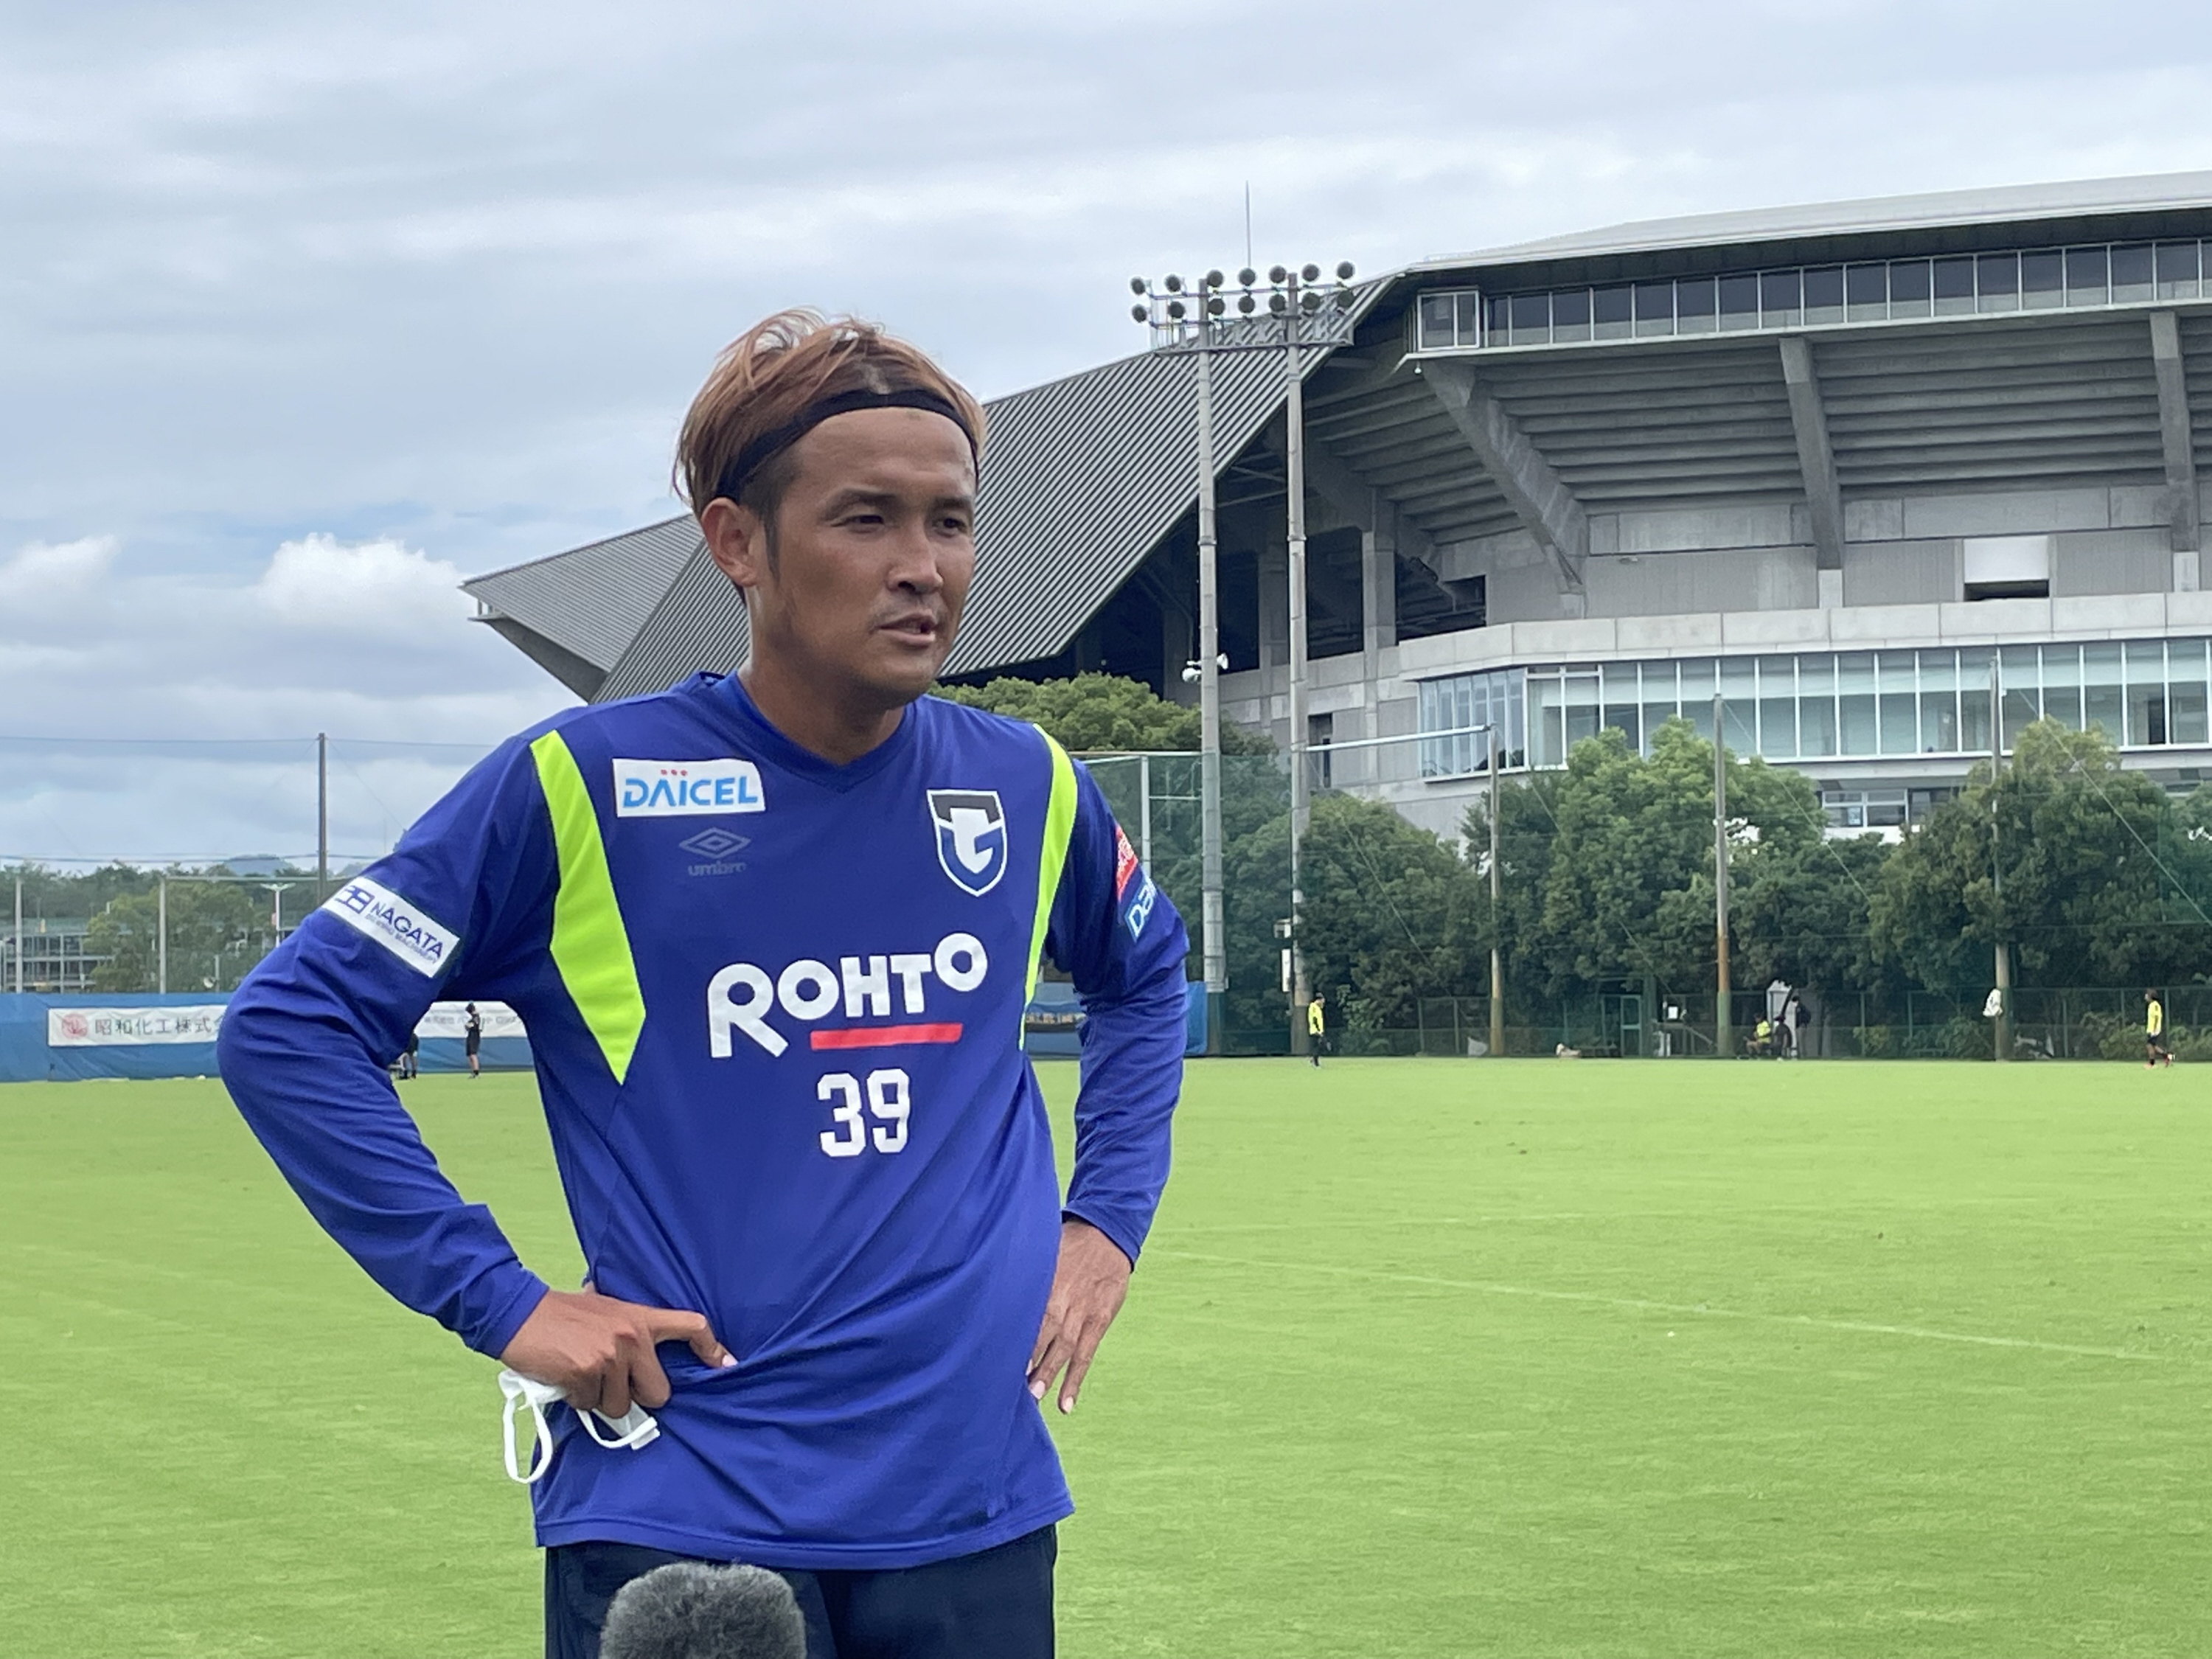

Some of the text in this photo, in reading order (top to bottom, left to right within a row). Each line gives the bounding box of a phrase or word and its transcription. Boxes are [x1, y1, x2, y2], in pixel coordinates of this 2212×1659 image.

[623, 770, 758, 807] DAICEL
[688, 860, 747, 877] umbro
[370, 902, 443, 959] NAGATA
[707, 933, 989, 1059] ROHTO
[817, 1068, 911, 1157] 39
